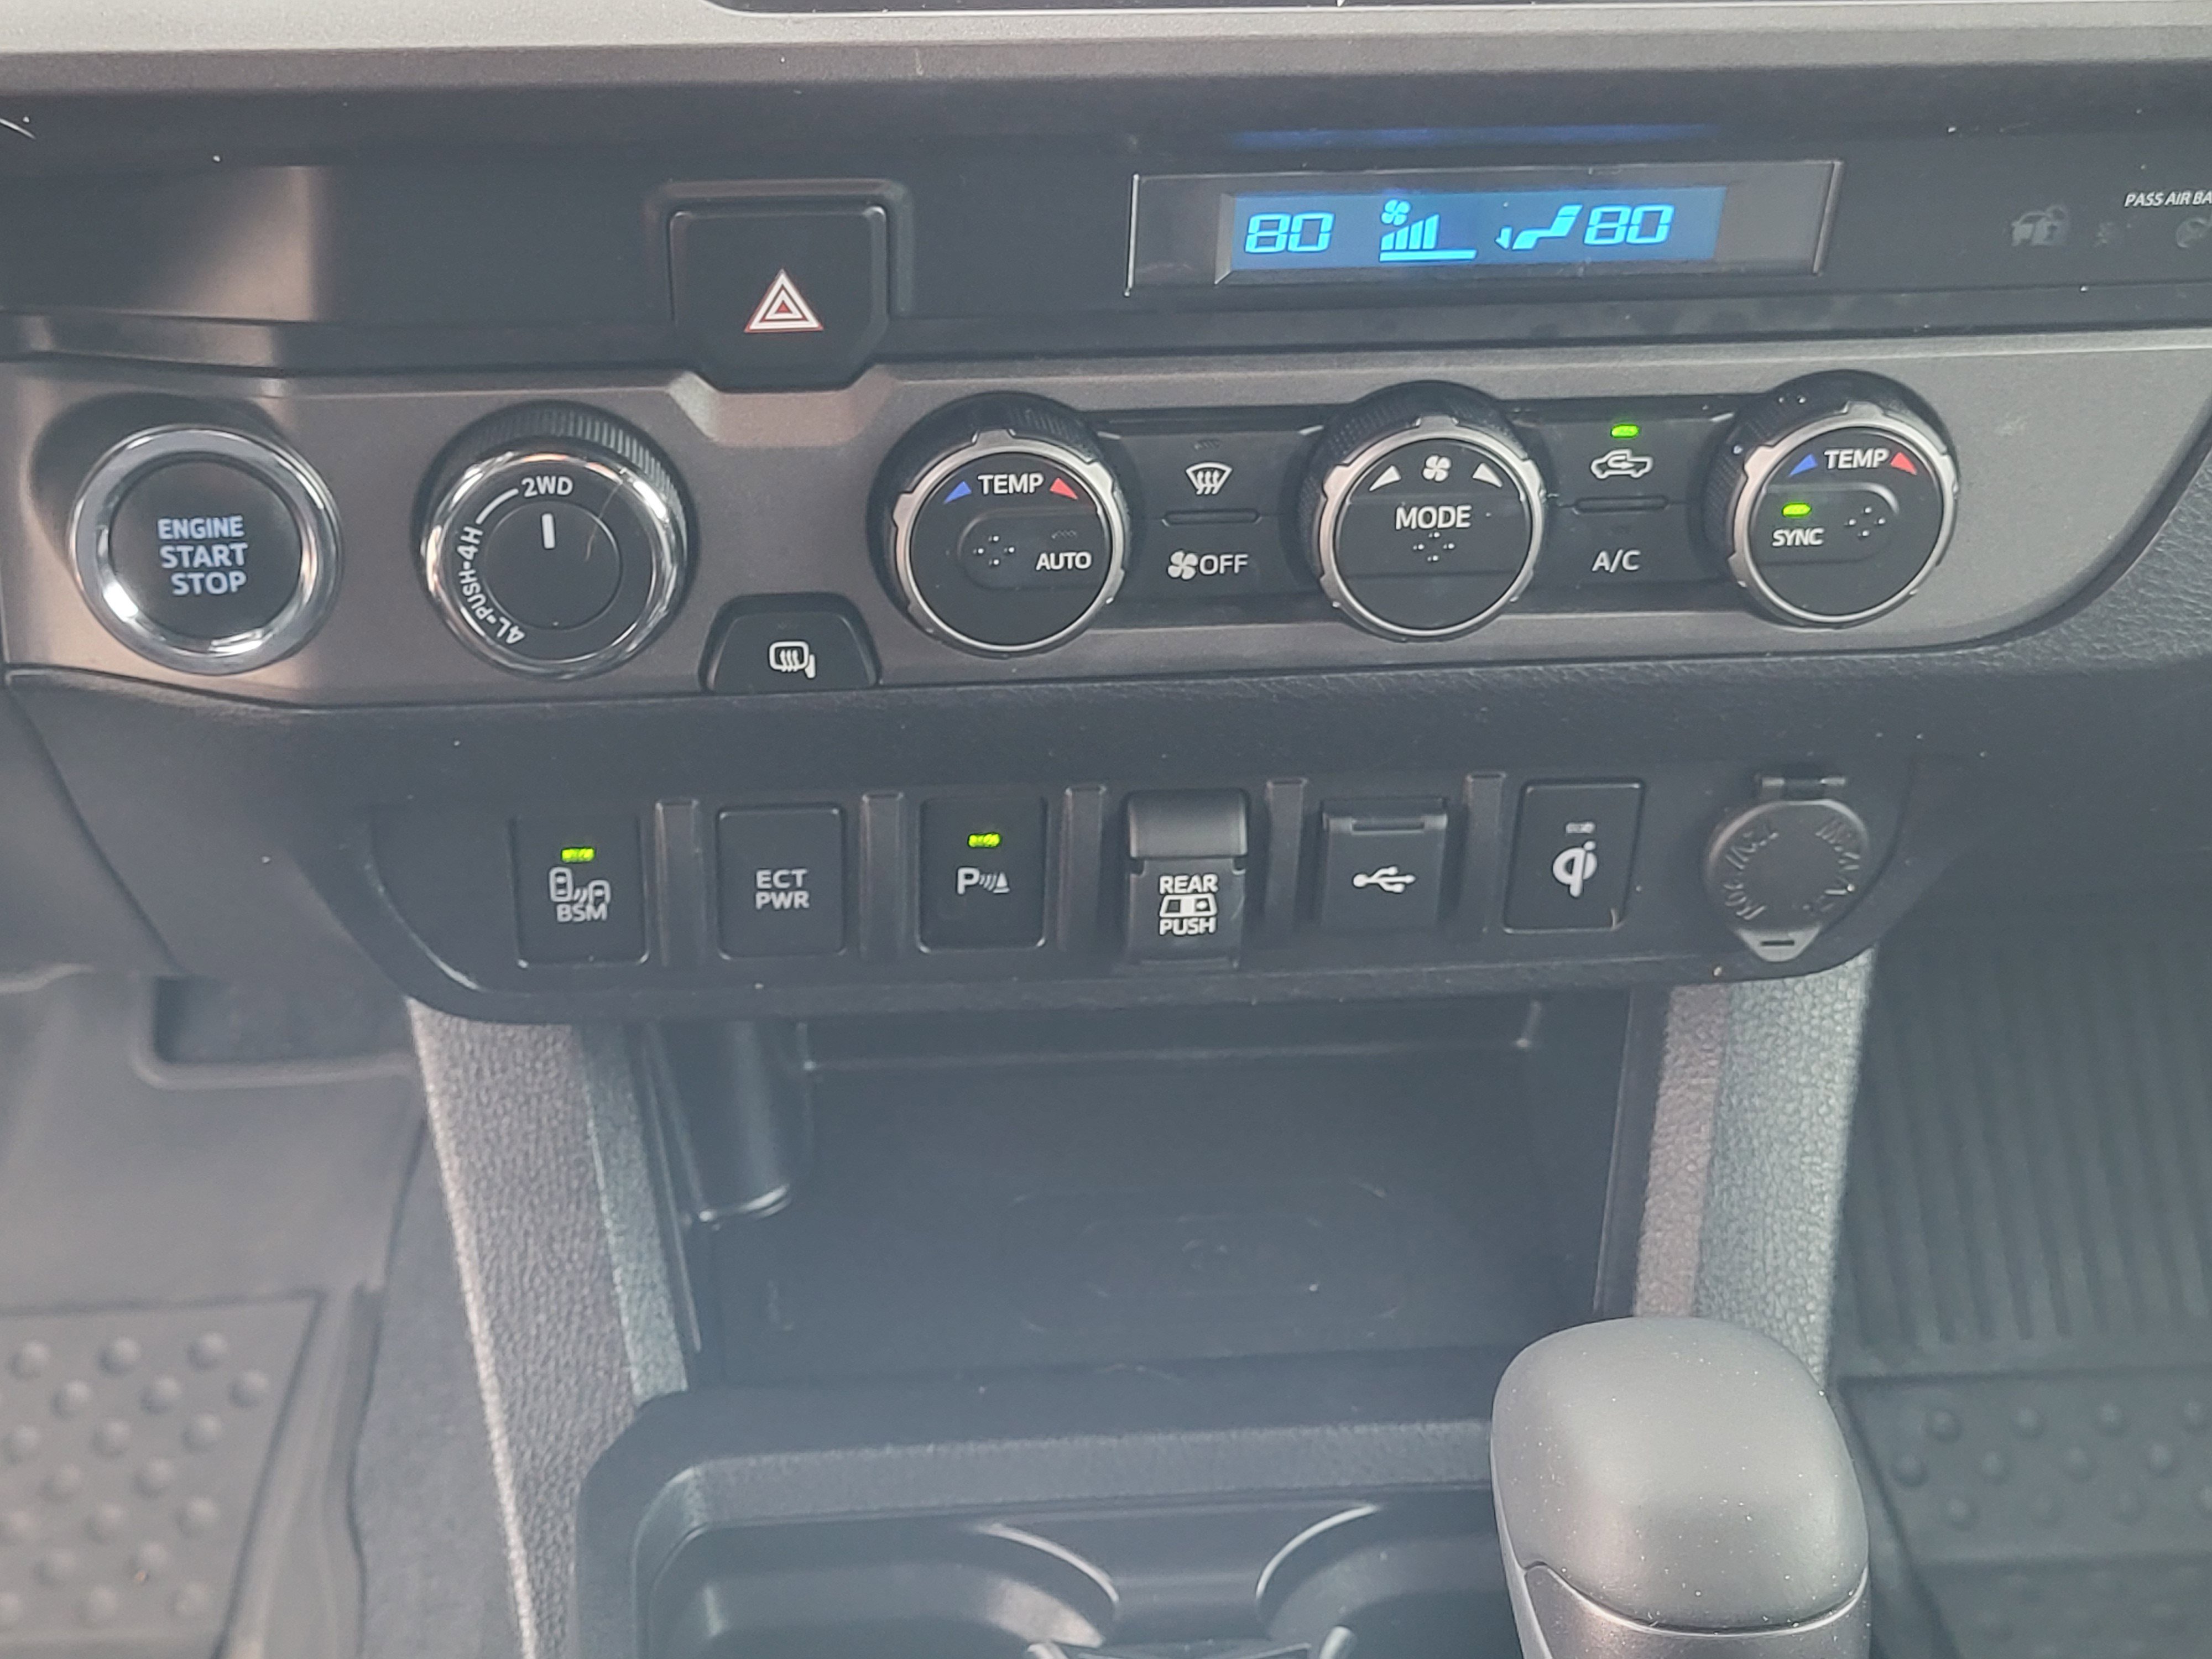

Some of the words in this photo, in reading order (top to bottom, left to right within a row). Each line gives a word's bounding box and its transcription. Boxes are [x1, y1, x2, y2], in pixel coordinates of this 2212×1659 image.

[2124, 191, 2164, 207] PASS
[2164, 190, 2191, 205] AIR
[1245, 212, 1334, 254] 80
[1583, 204, 1675, 246] 80
[1824, 448, 1890, 469] TEMP
[521, 476, 573, 497] 2WD
[978, 472, 1045, 495] TEMP
[157, 514, 246, 540] ENGINE
[1395, 504, 1472, 530] MODE
[1772, 528, 1824, 547] SYNC
[159, 542, 248, 568] START
[1035, 551, 1092, 571] AUTO
[1199, 554, 1249, 575] OFF
[1592, 549, 1641, 573] A/C
[170, 570, 247, 596] STOP
[755, 868, 808, 889] ECT
[1159, 873, 1219, 894] REAR
[755, 890, 810, 910] PWR
[556, 902, 608, 922] BSM
[1159, 916, 1217, 936] PUSH
